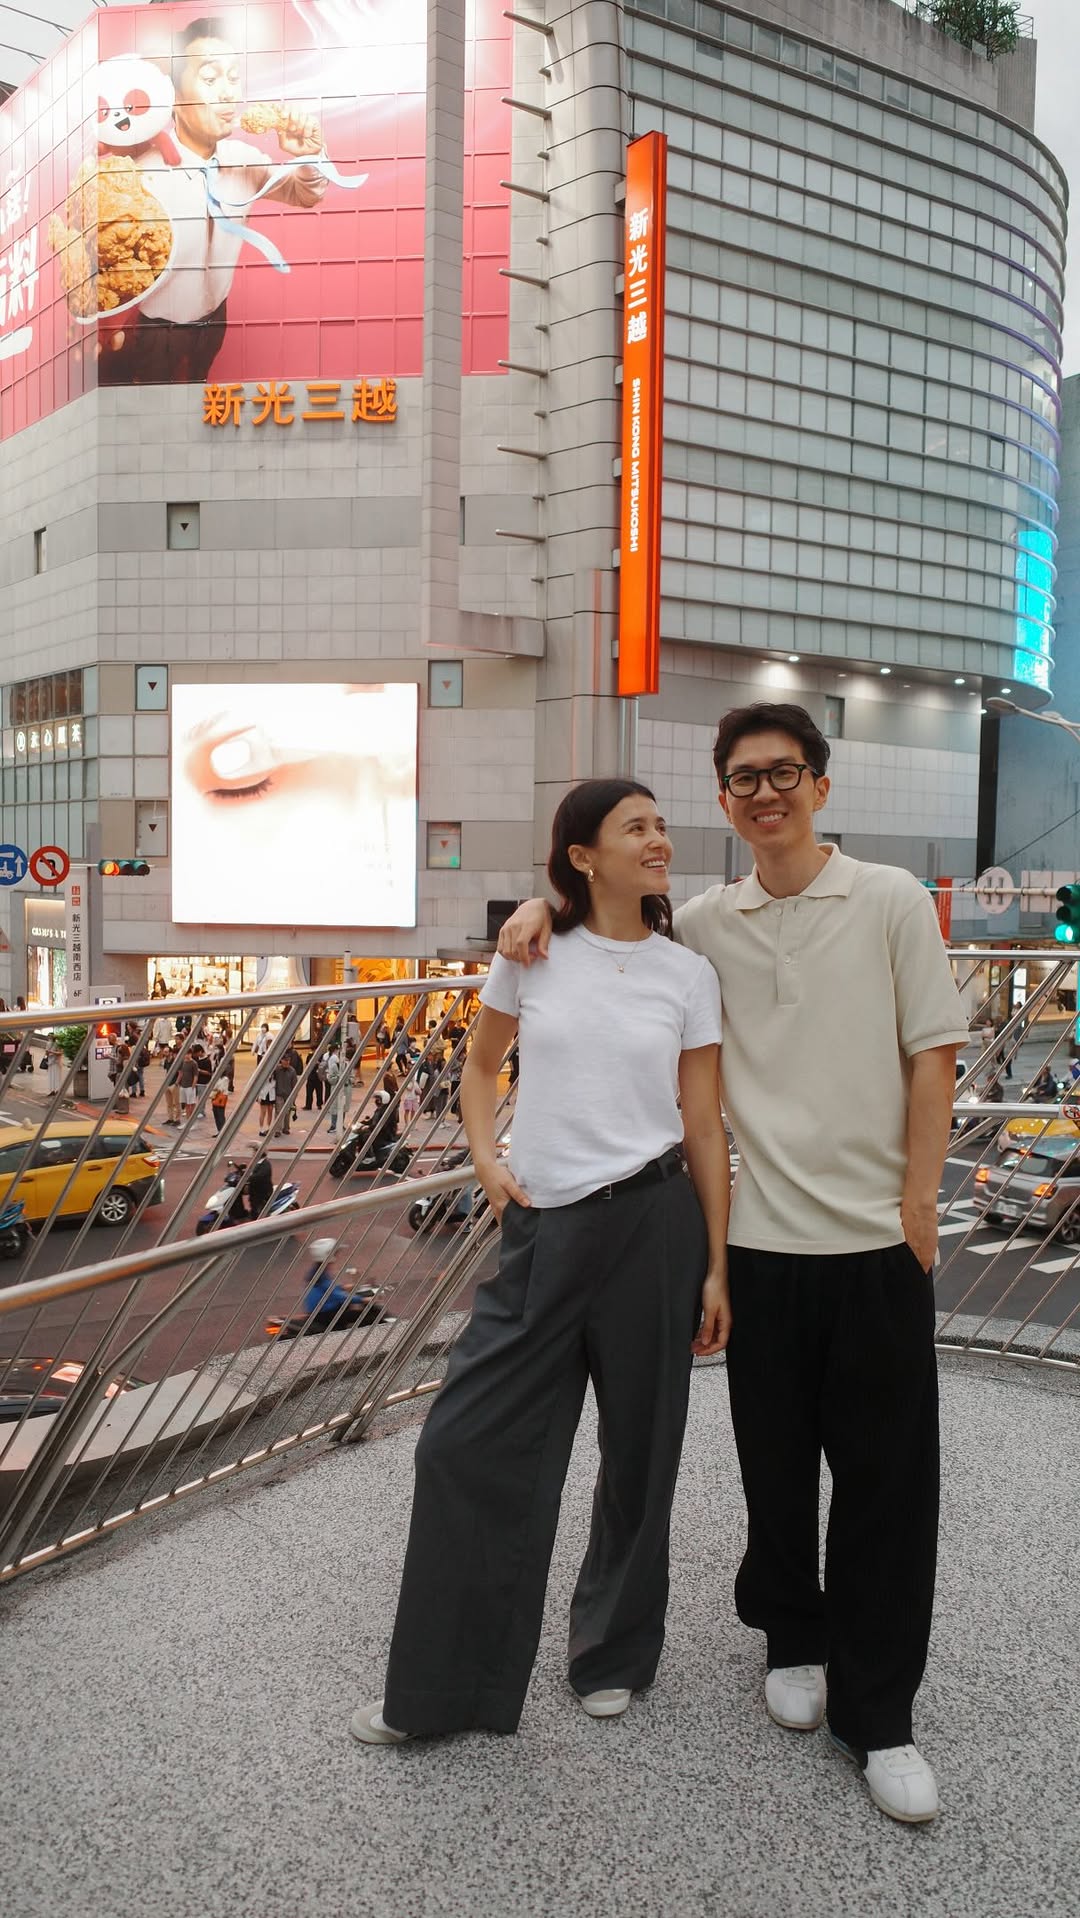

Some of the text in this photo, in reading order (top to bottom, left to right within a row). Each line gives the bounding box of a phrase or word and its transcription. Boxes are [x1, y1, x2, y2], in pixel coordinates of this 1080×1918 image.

[0, 226, 39, 326] 料
[628, 208, 648, 344] 新光三越
[203, 376, 398, 427] 新光三越
[630, 378, 641, 552] SHIN KONG MITSUKOSHI
[72, 913, 82, 981] 新光三越南西店
